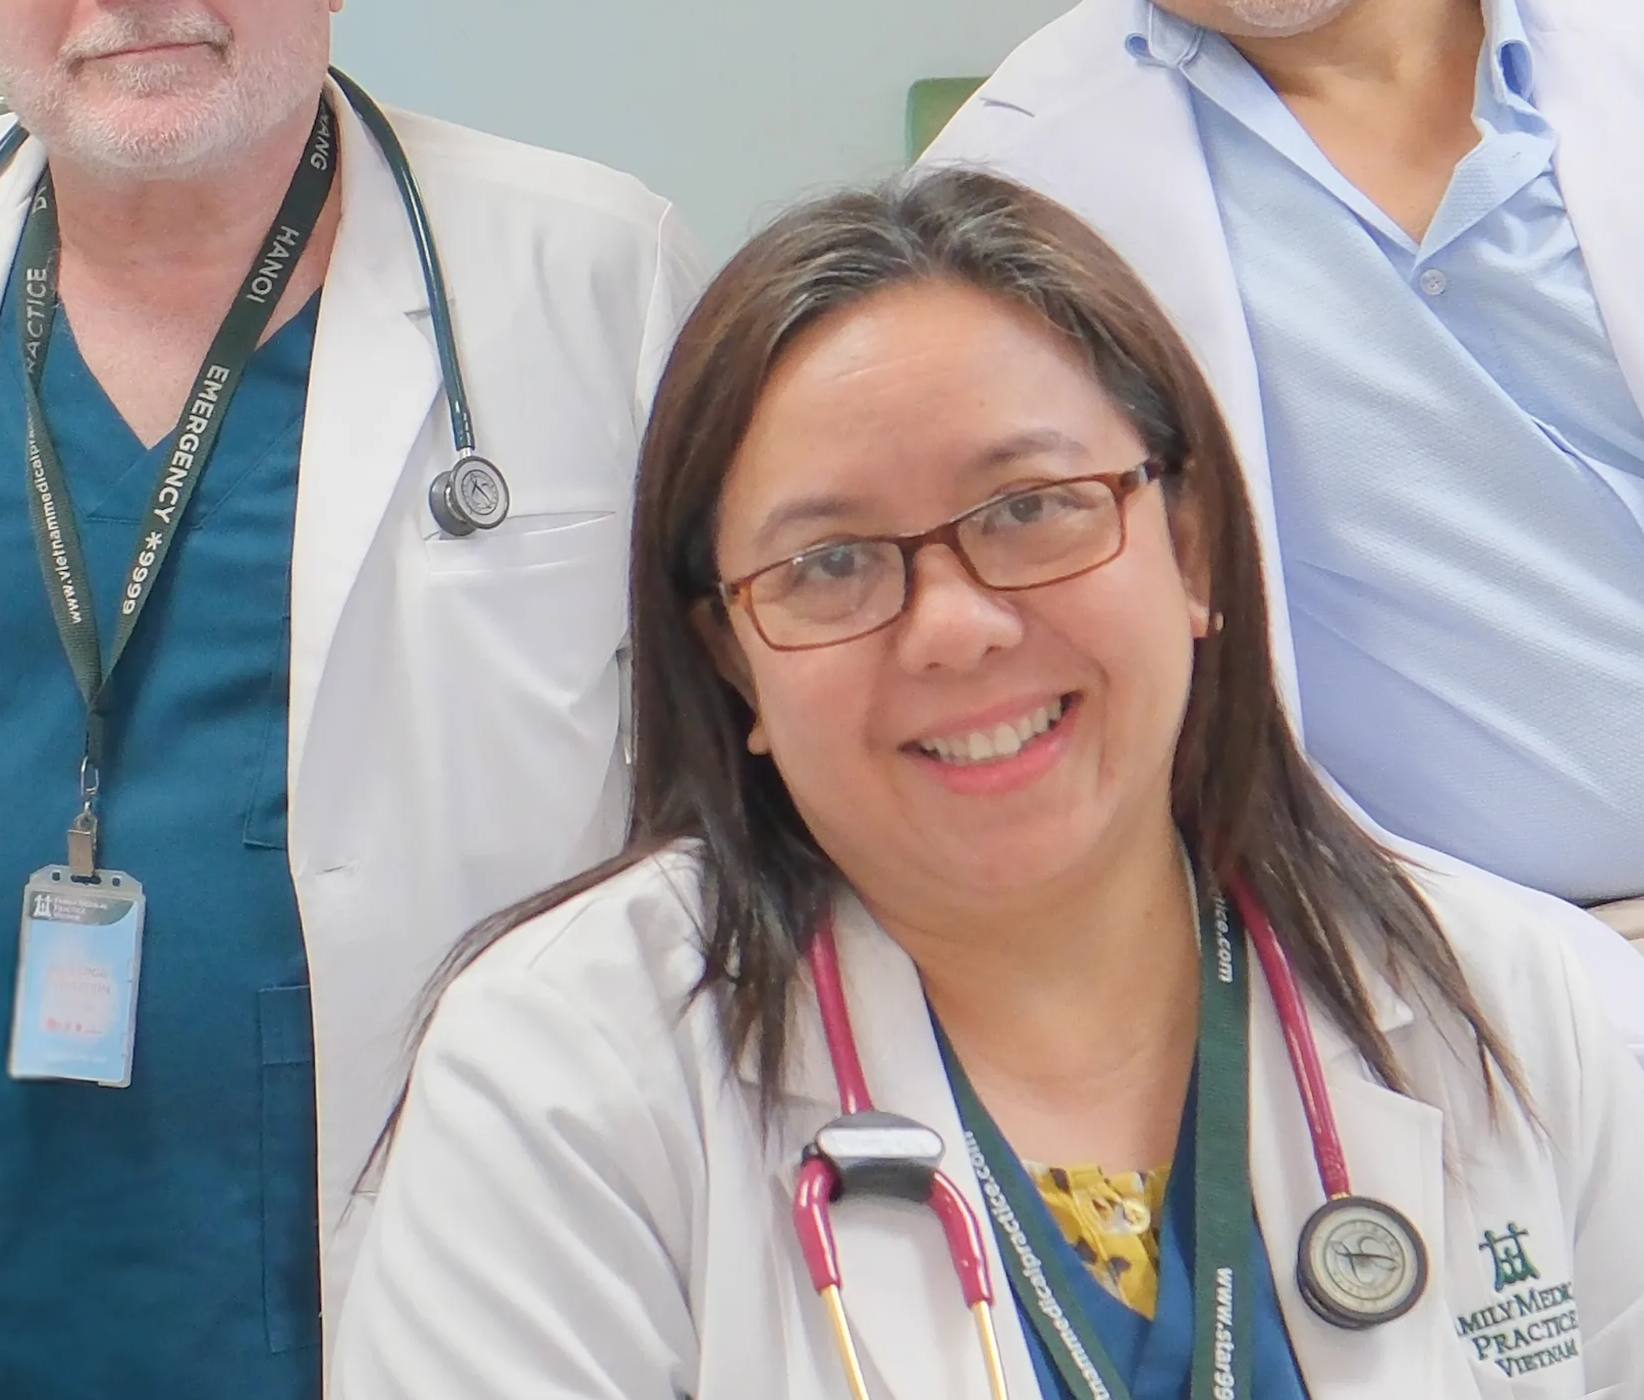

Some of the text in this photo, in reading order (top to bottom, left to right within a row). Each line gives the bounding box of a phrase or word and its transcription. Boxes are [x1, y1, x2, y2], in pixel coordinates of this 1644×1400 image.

[246, 225, 300, 303] HANOI
[158, 363, 230, 524] EMERGENCY
[1471, 1310, 1579, 1361] PRACTICE
[1494, 1338, 1579, 1378] VIETNAM
